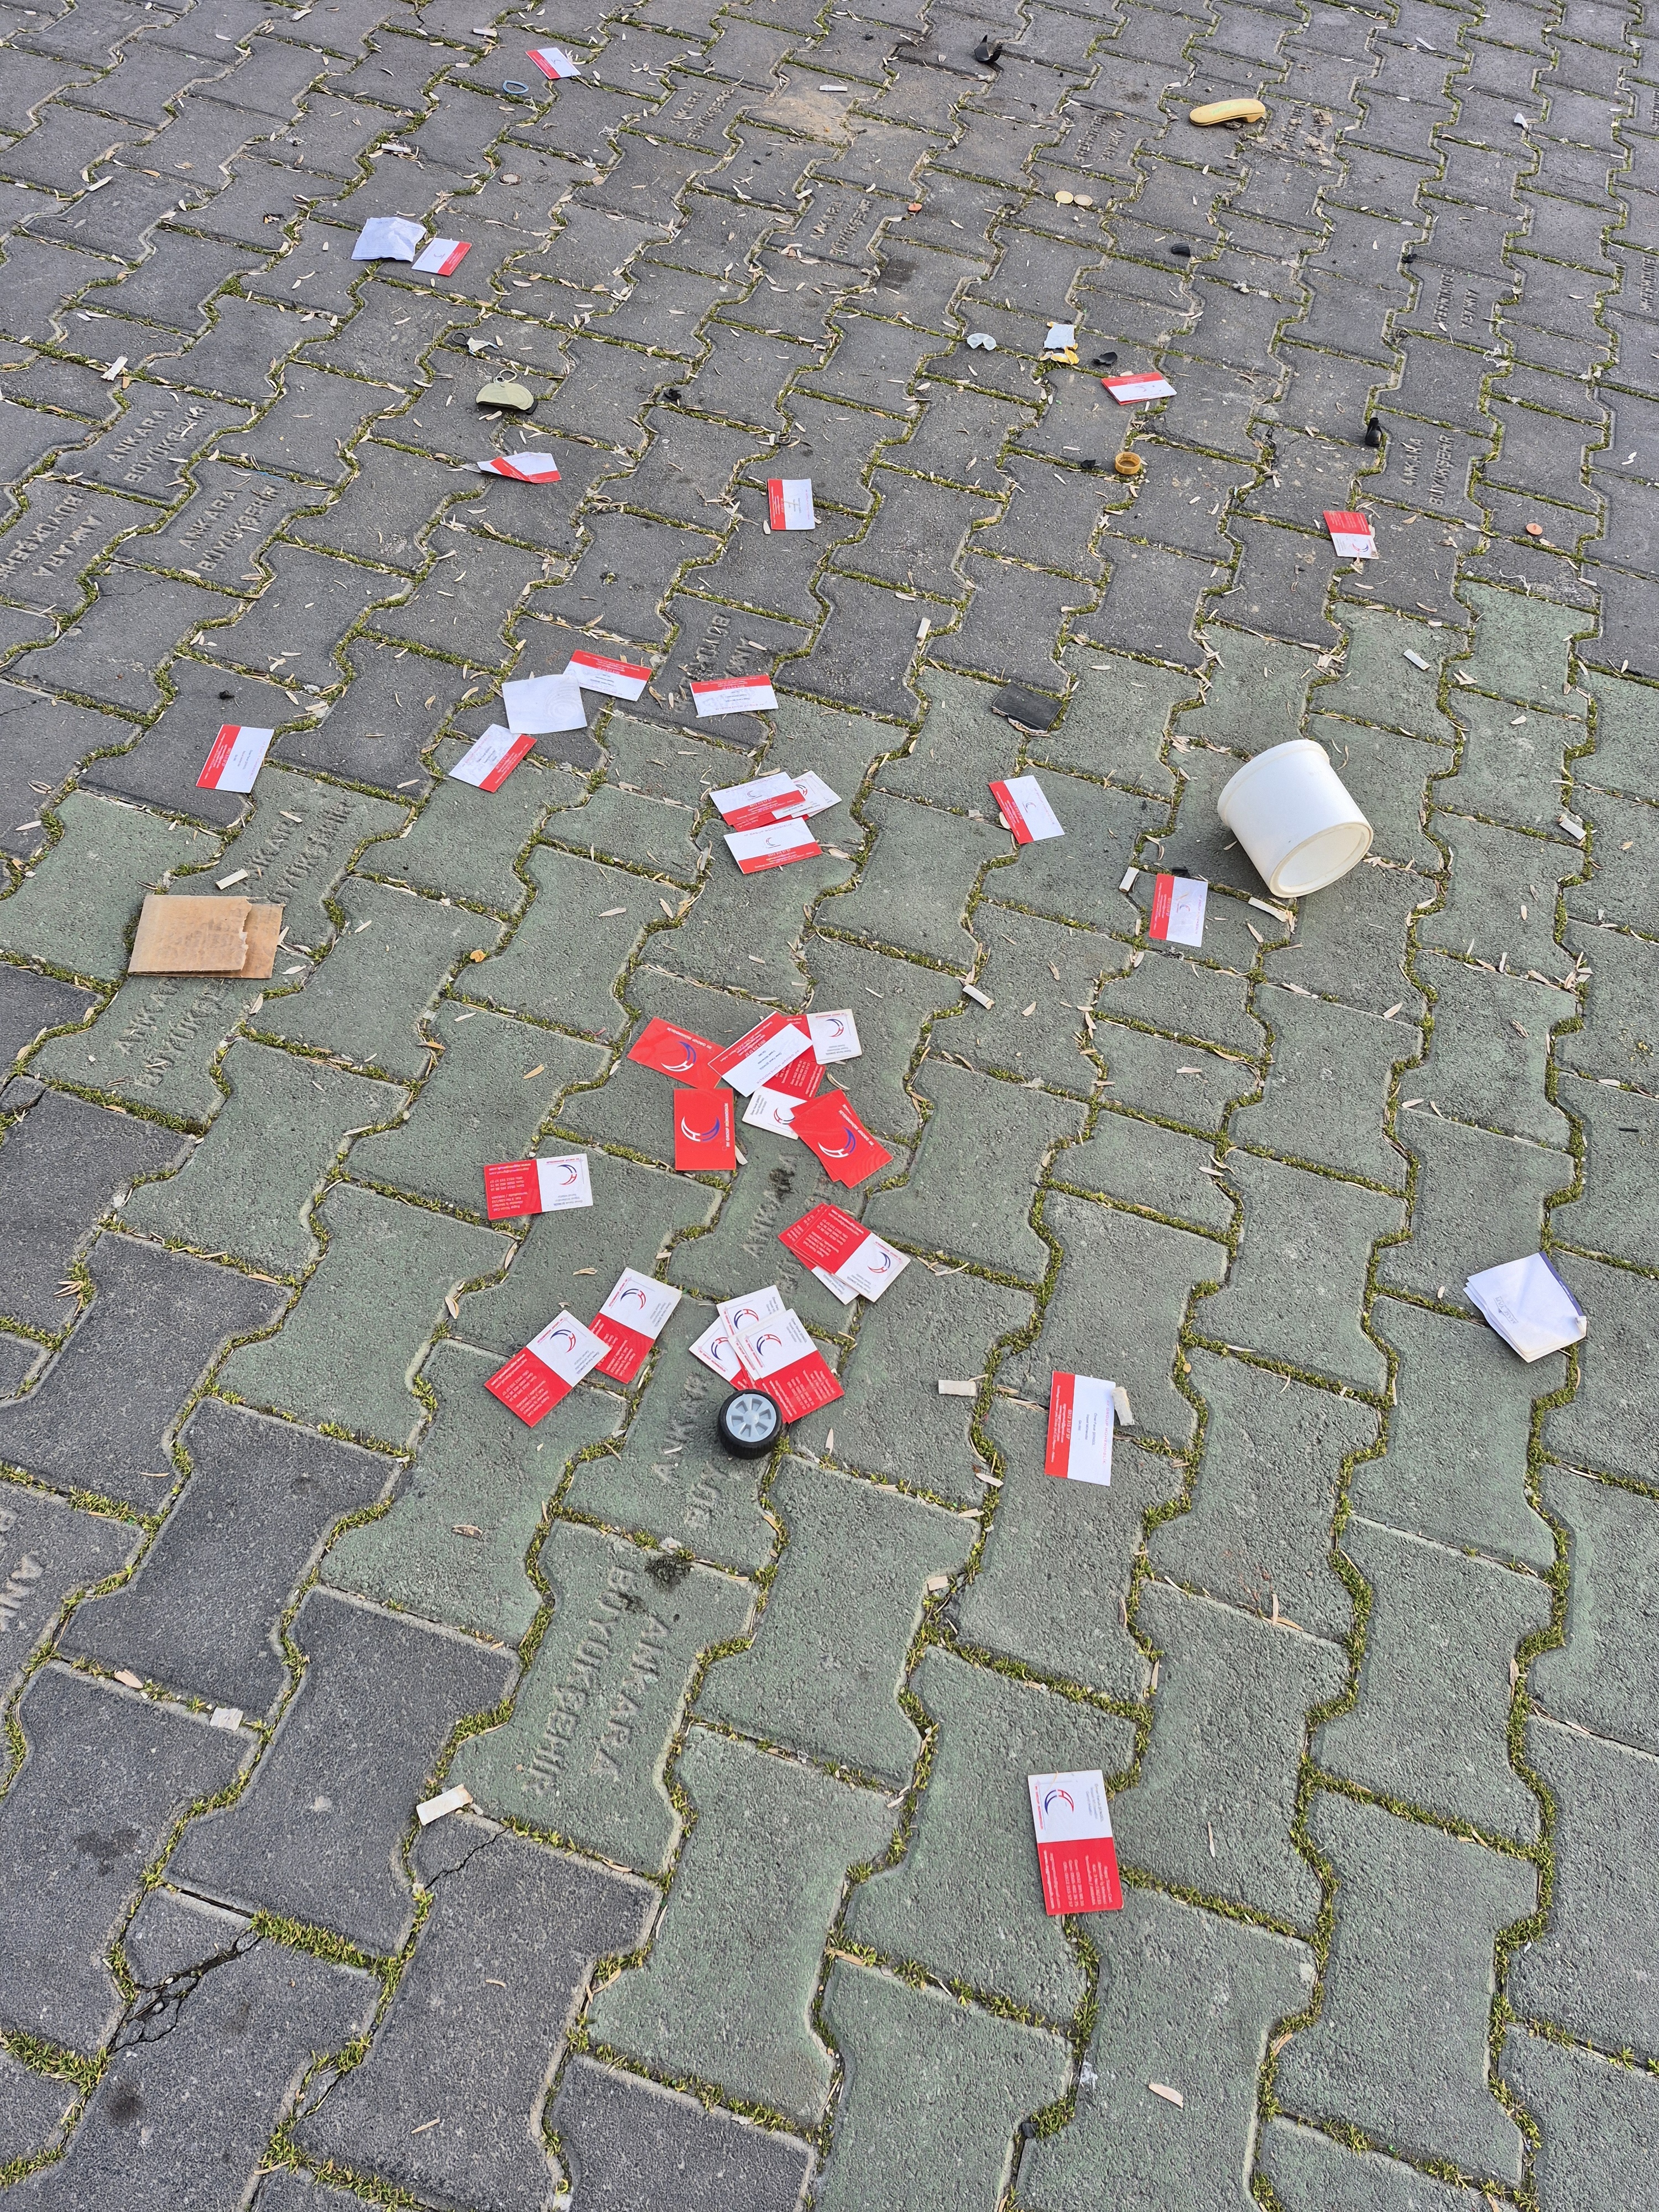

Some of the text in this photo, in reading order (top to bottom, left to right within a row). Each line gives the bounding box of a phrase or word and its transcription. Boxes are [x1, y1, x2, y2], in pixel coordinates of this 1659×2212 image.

[107, 410, 172, 463] ANKARA
[32, 515, 105, 577] ANKARA
[179, 489, 242, 549] ANKARA
[691, 1037, 706, 1047] GROUP
[857, 1129, 869, 1140] GROUP
[592, 1615, 669, 1771] ANKARA
